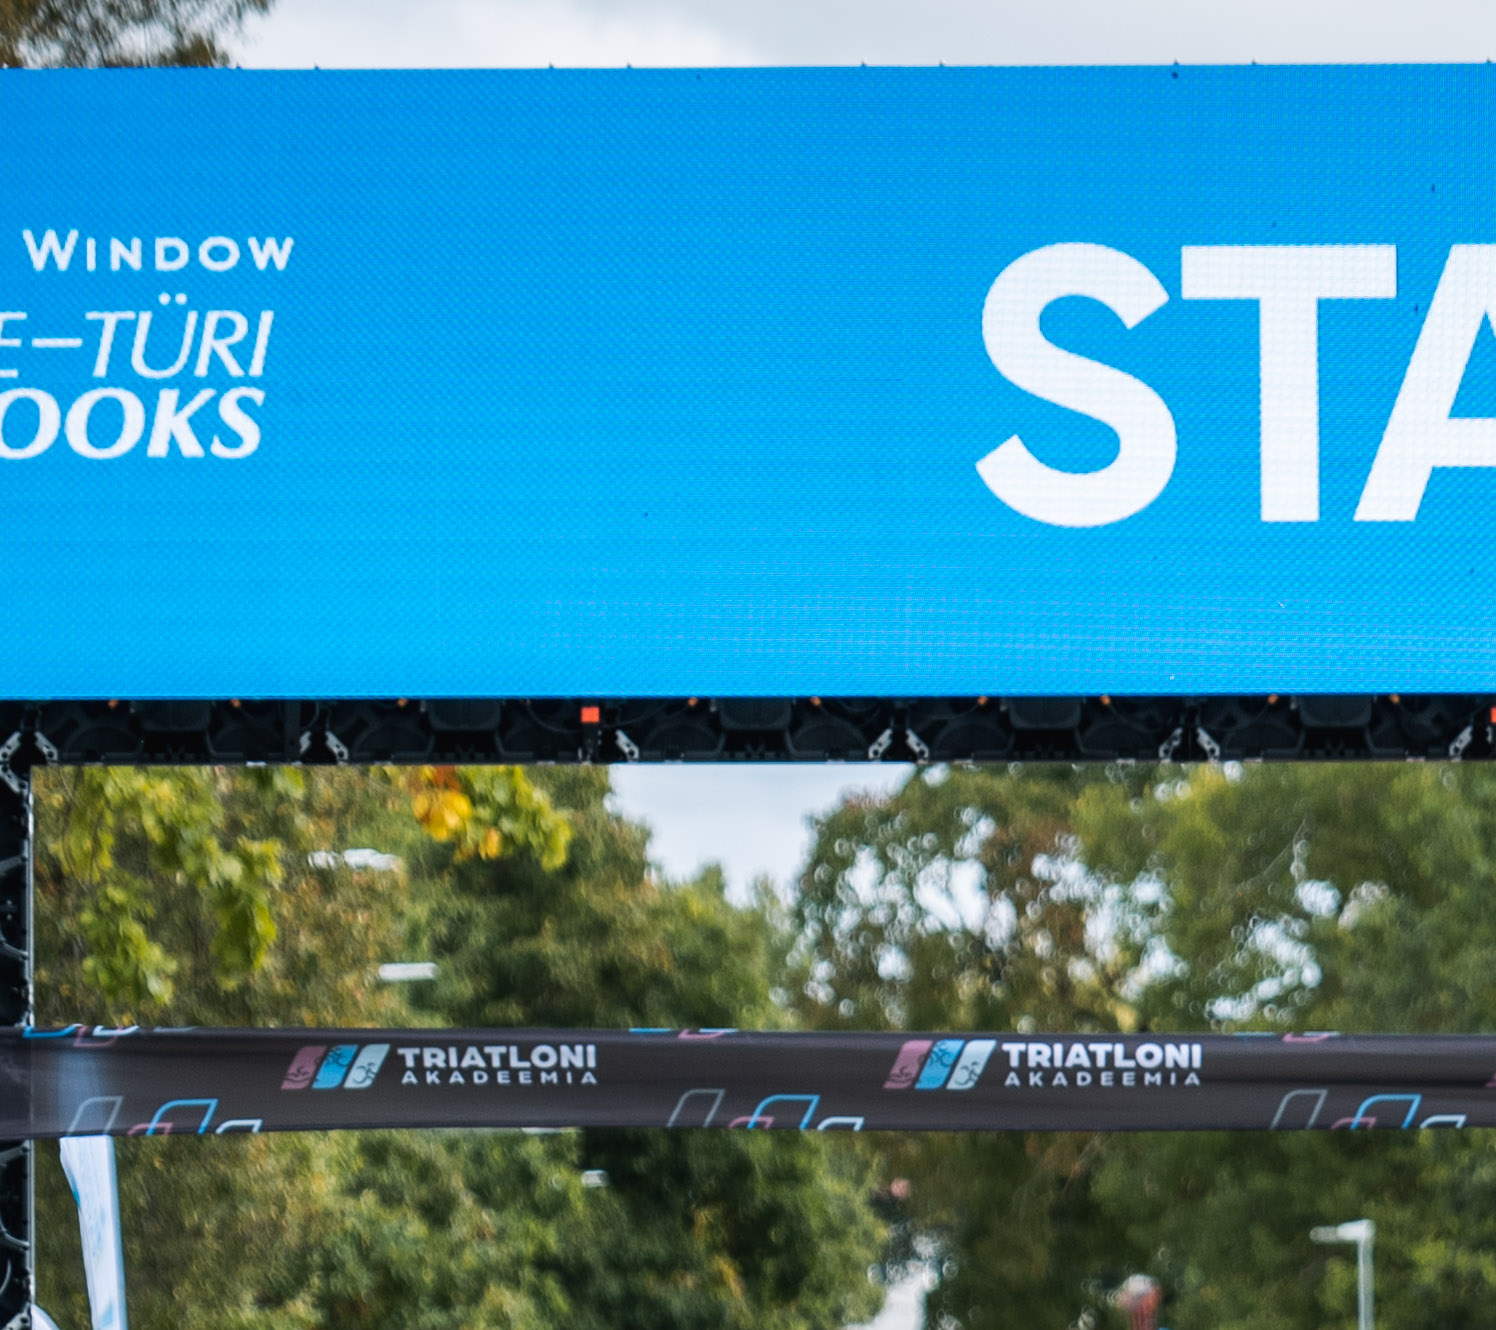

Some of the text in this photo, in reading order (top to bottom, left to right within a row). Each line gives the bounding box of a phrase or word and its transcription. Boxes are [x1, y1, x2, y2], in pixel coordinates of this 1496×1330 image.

[397, 1044, 597, 1070] TRIATLONI
[1002, 1041, 1202, 1070] TRIATLONI
[401, 1070, 598, 1086] AKADEEMIA
[1004, 1070, 1201, 1087] AKADEEMIA
